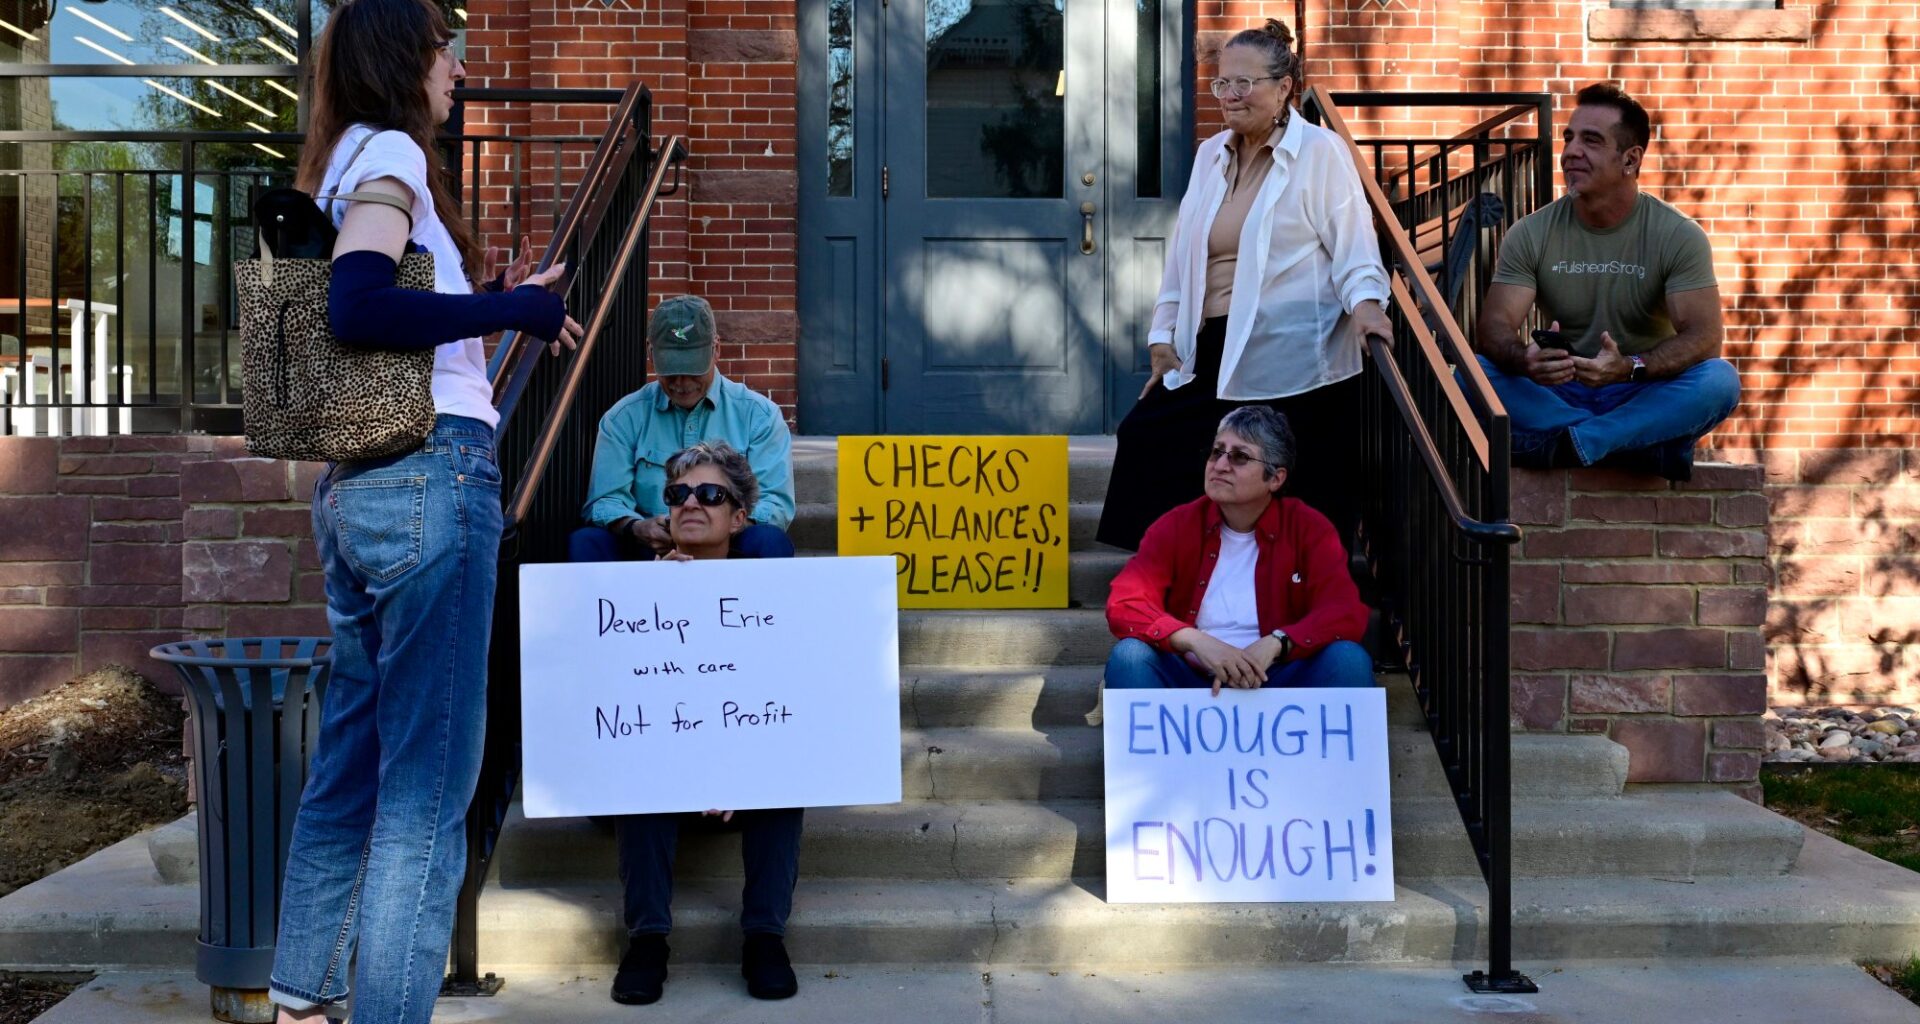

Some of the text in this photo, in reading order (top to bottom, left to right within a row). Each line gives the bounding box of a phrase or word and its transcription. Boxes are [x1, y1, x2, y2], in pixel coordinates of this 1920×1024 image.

[863, 441, 1030, 496] CHECKS
[849, 499, 1061, 546] + BALANCES,
[598, 597, 775, 644] Develop Erie
[633, 656, 737, 676] with care
[596, 700, 793, 740] Not for Profit
[1128, 701, 1354, 761] ENOUGH
[1227, 767, 1270, 810] IS
[1132, 808, 1376, 884] ENOUGH!
